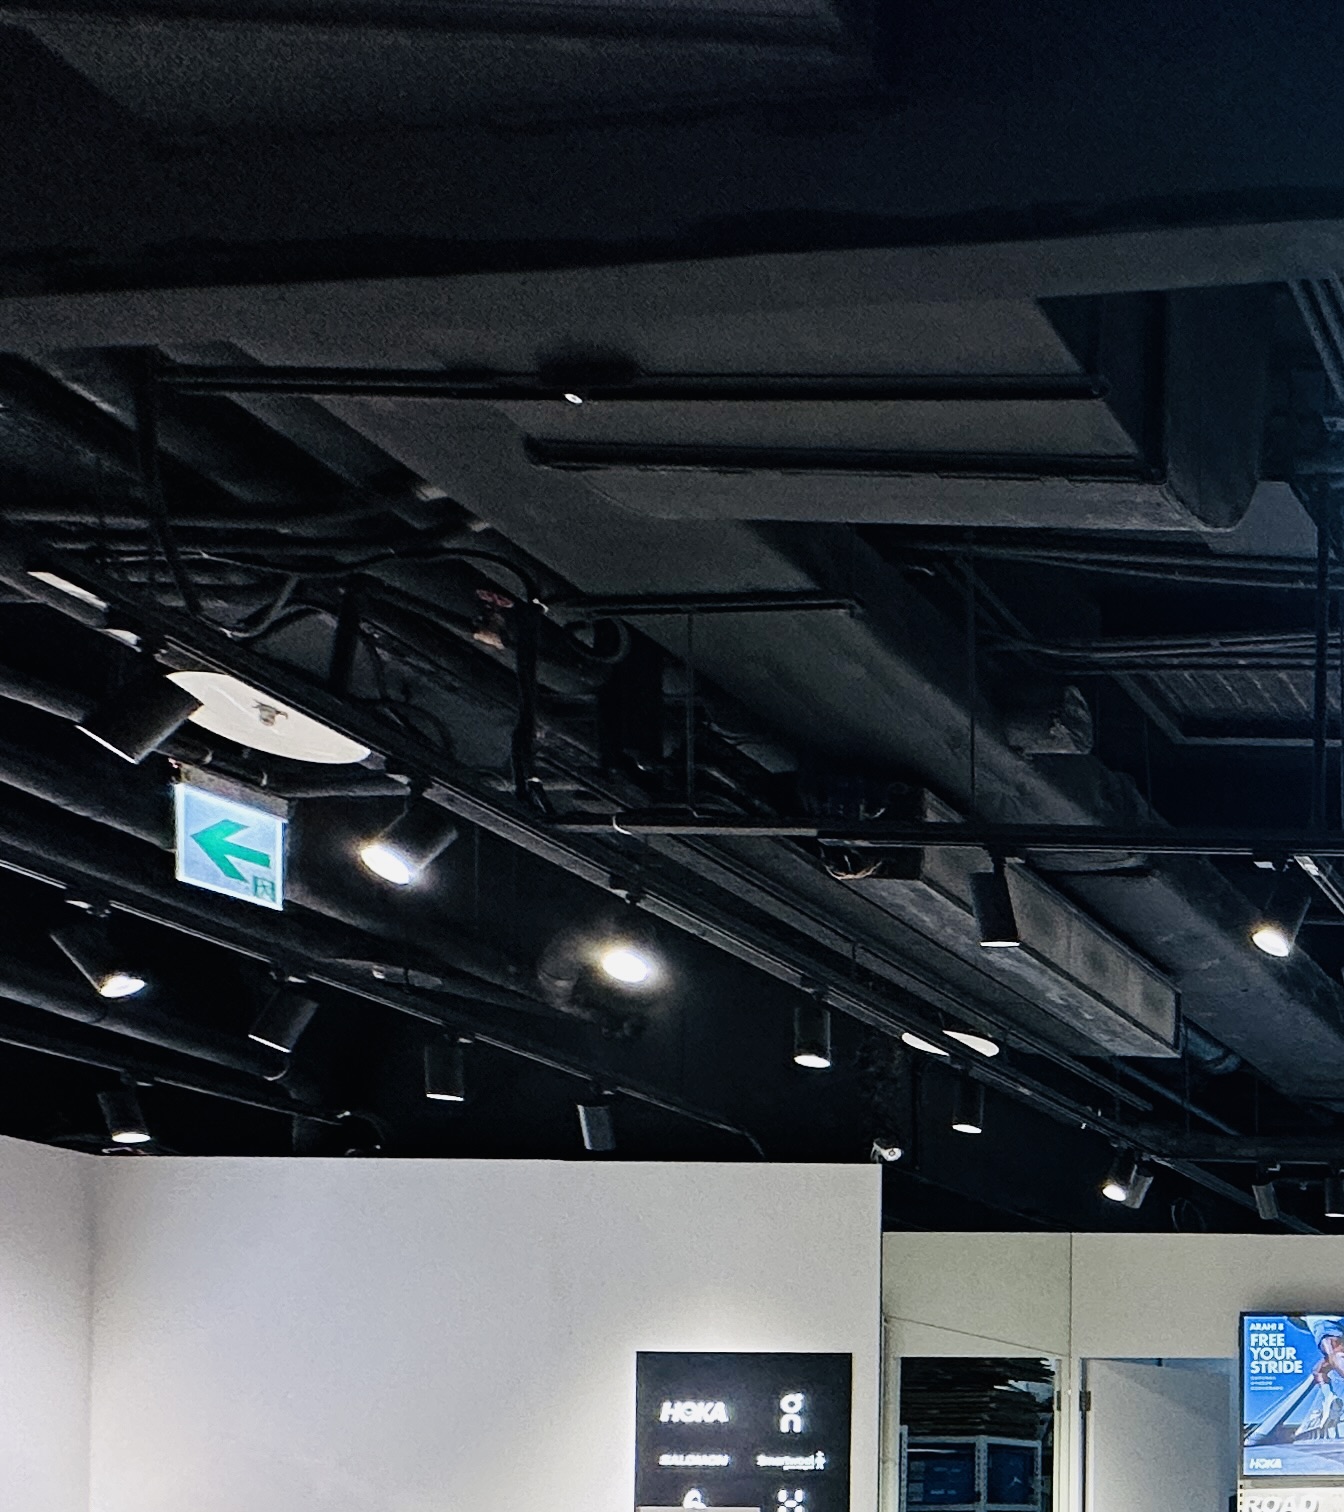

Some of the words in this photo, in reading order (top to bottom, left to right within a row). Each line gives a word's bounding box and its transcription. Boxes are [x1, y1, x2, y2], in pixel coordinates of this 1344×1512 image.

[1250, 1333, 1285, 1347] FREE
[1249, 1347, 1296, 1361] YOUR
[1250, 1360, 1303, 1374] STRIDE
[659, 1400, 730, 1423] HOKA
[1249, 1458, 1283, 1470] HOKA
